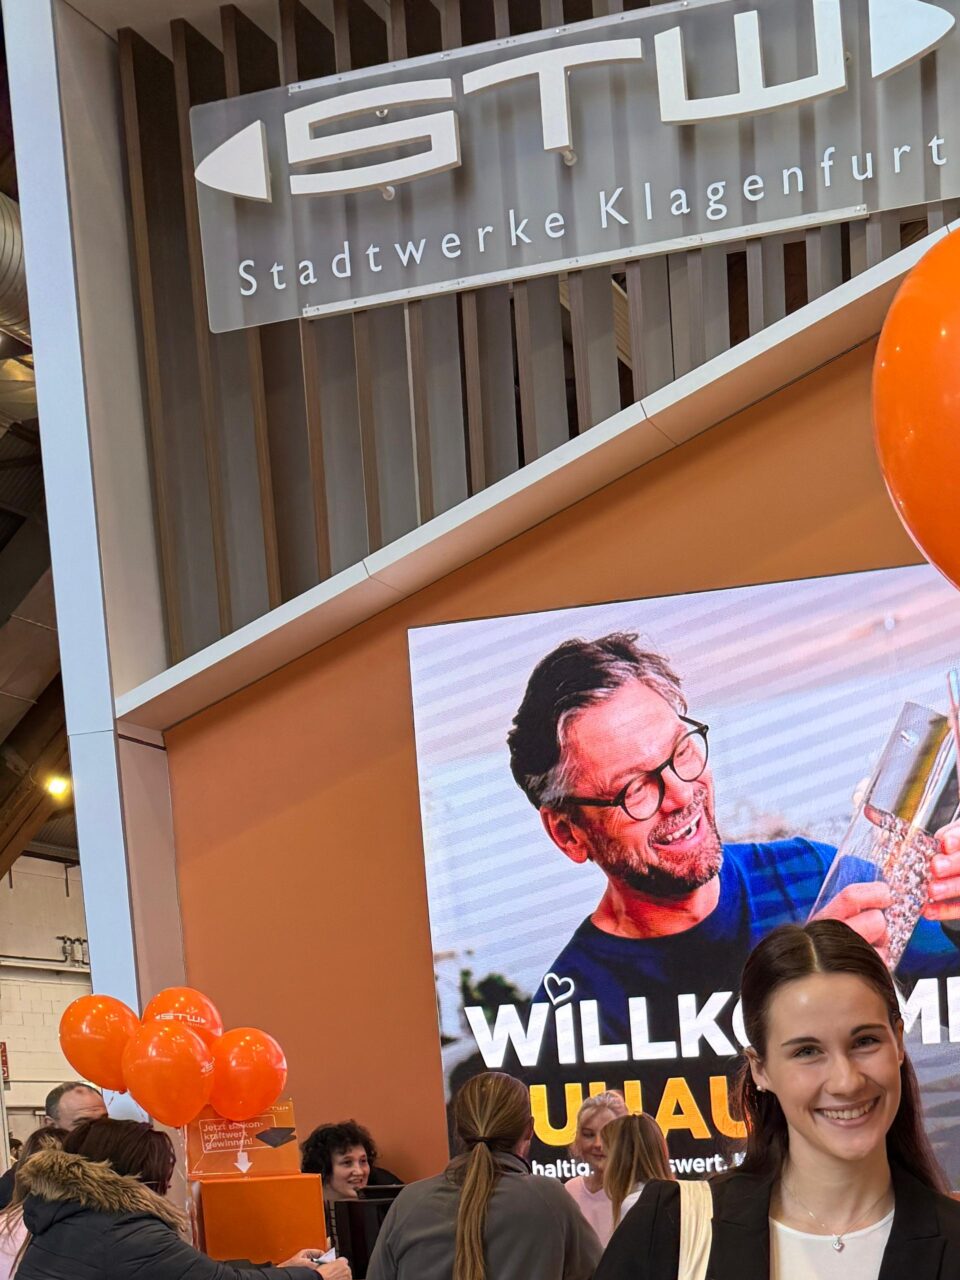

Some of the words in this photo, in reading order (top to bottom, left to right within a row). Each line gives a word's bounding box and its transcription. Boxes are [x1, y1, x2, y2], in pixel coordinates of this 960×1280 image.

[284, 0, 847, 195] STW
[239, 210, 565, 297] Stadtwerke
[601, 134, 948, 230] Klagenfurt
